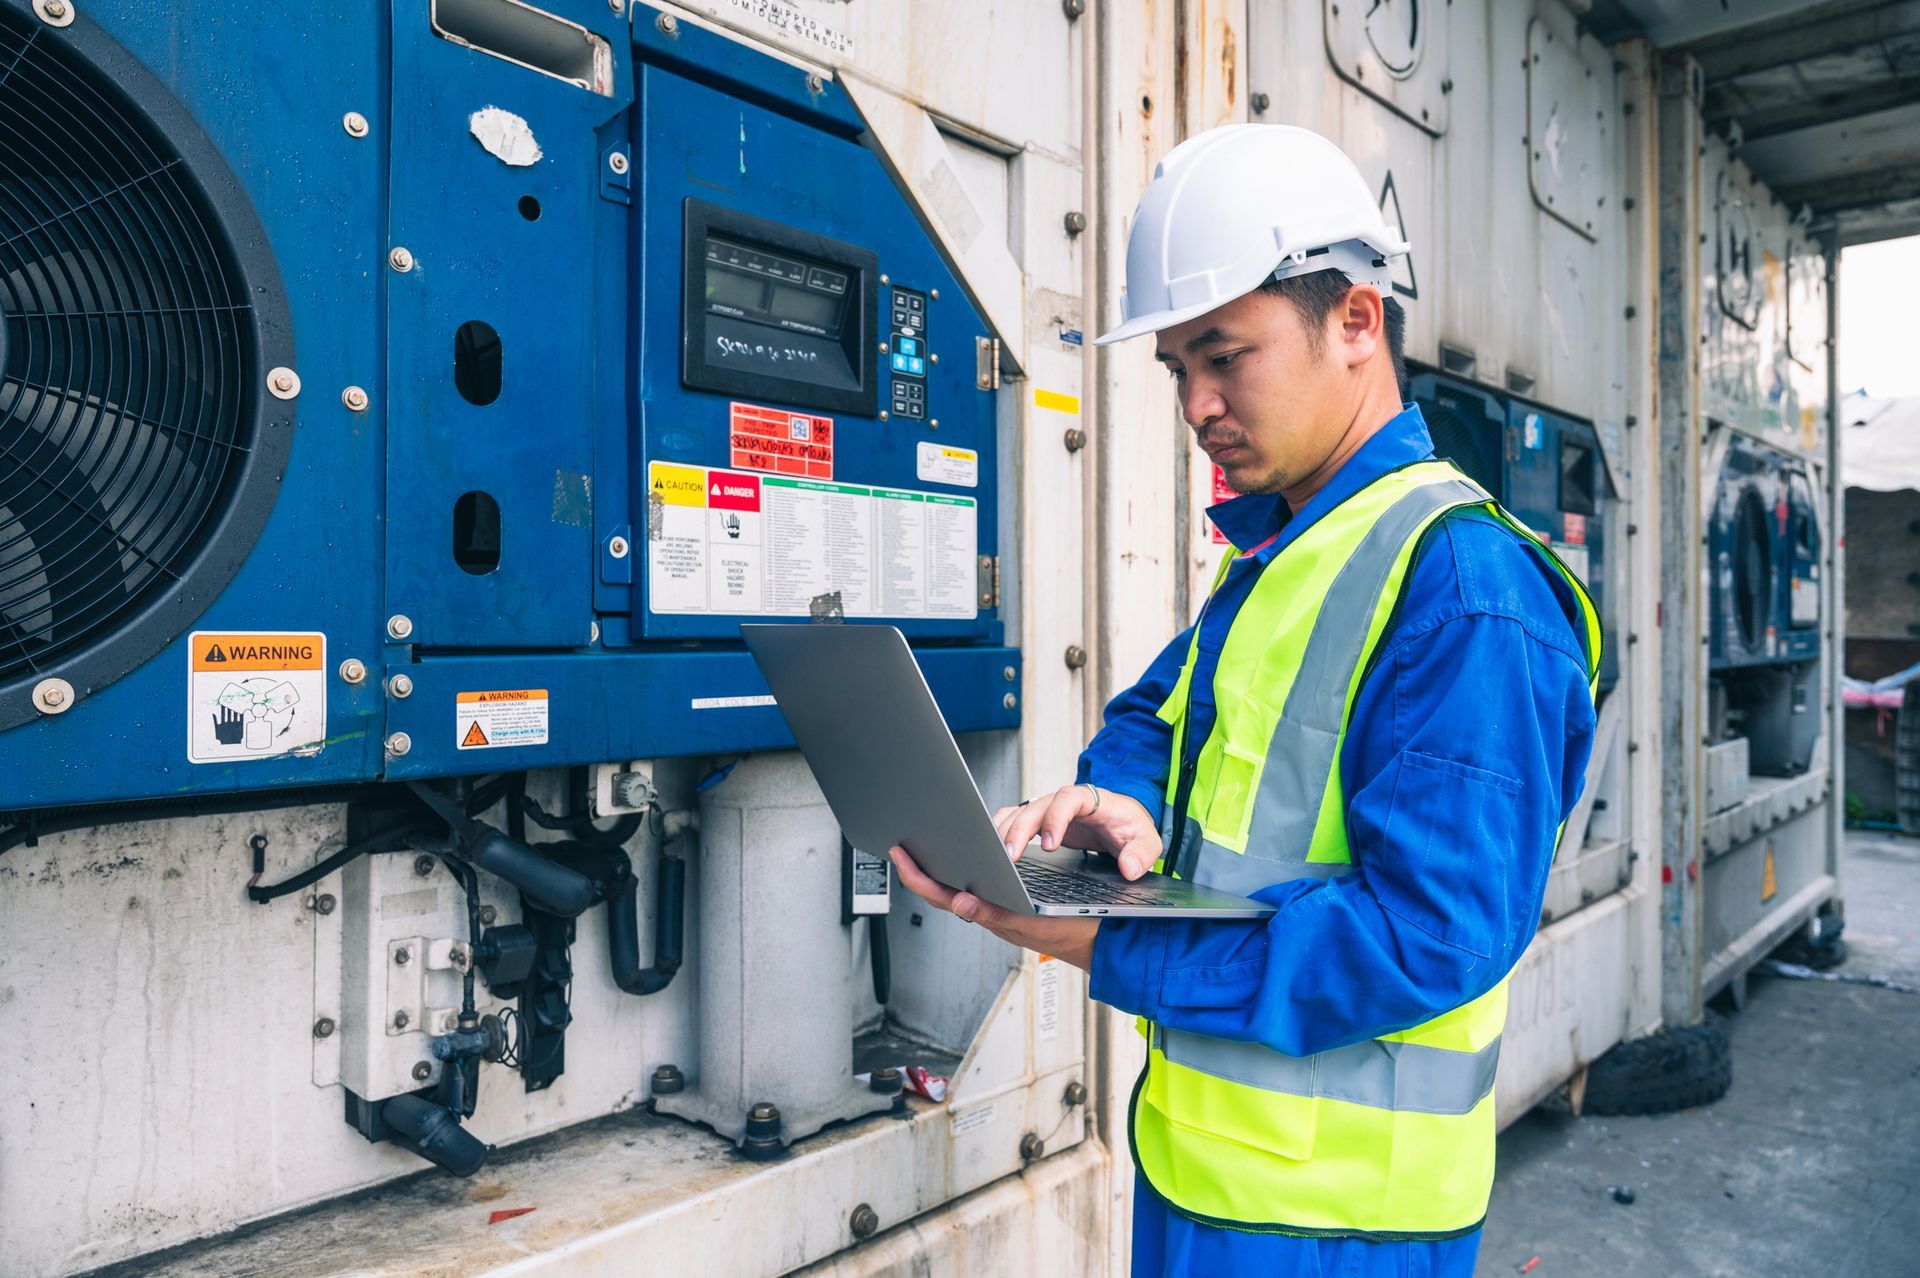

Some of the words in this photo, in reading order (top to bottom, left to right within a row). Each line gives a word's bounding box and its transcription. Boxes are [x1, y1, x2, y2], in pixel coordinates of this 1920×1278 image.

[724, 0, 787, 28] UMIDITY
[825, 26, 853, 47] WITH
[666, 480, 703, 492] CAUTION
[723, 486, 755, 498] DANGER
[229, 646, 313, 660] WARNING
[488, 691, 529, 700] WARNING
[697, 699, 720, 707] USDA
[724, 698, 747, 706] COLD
